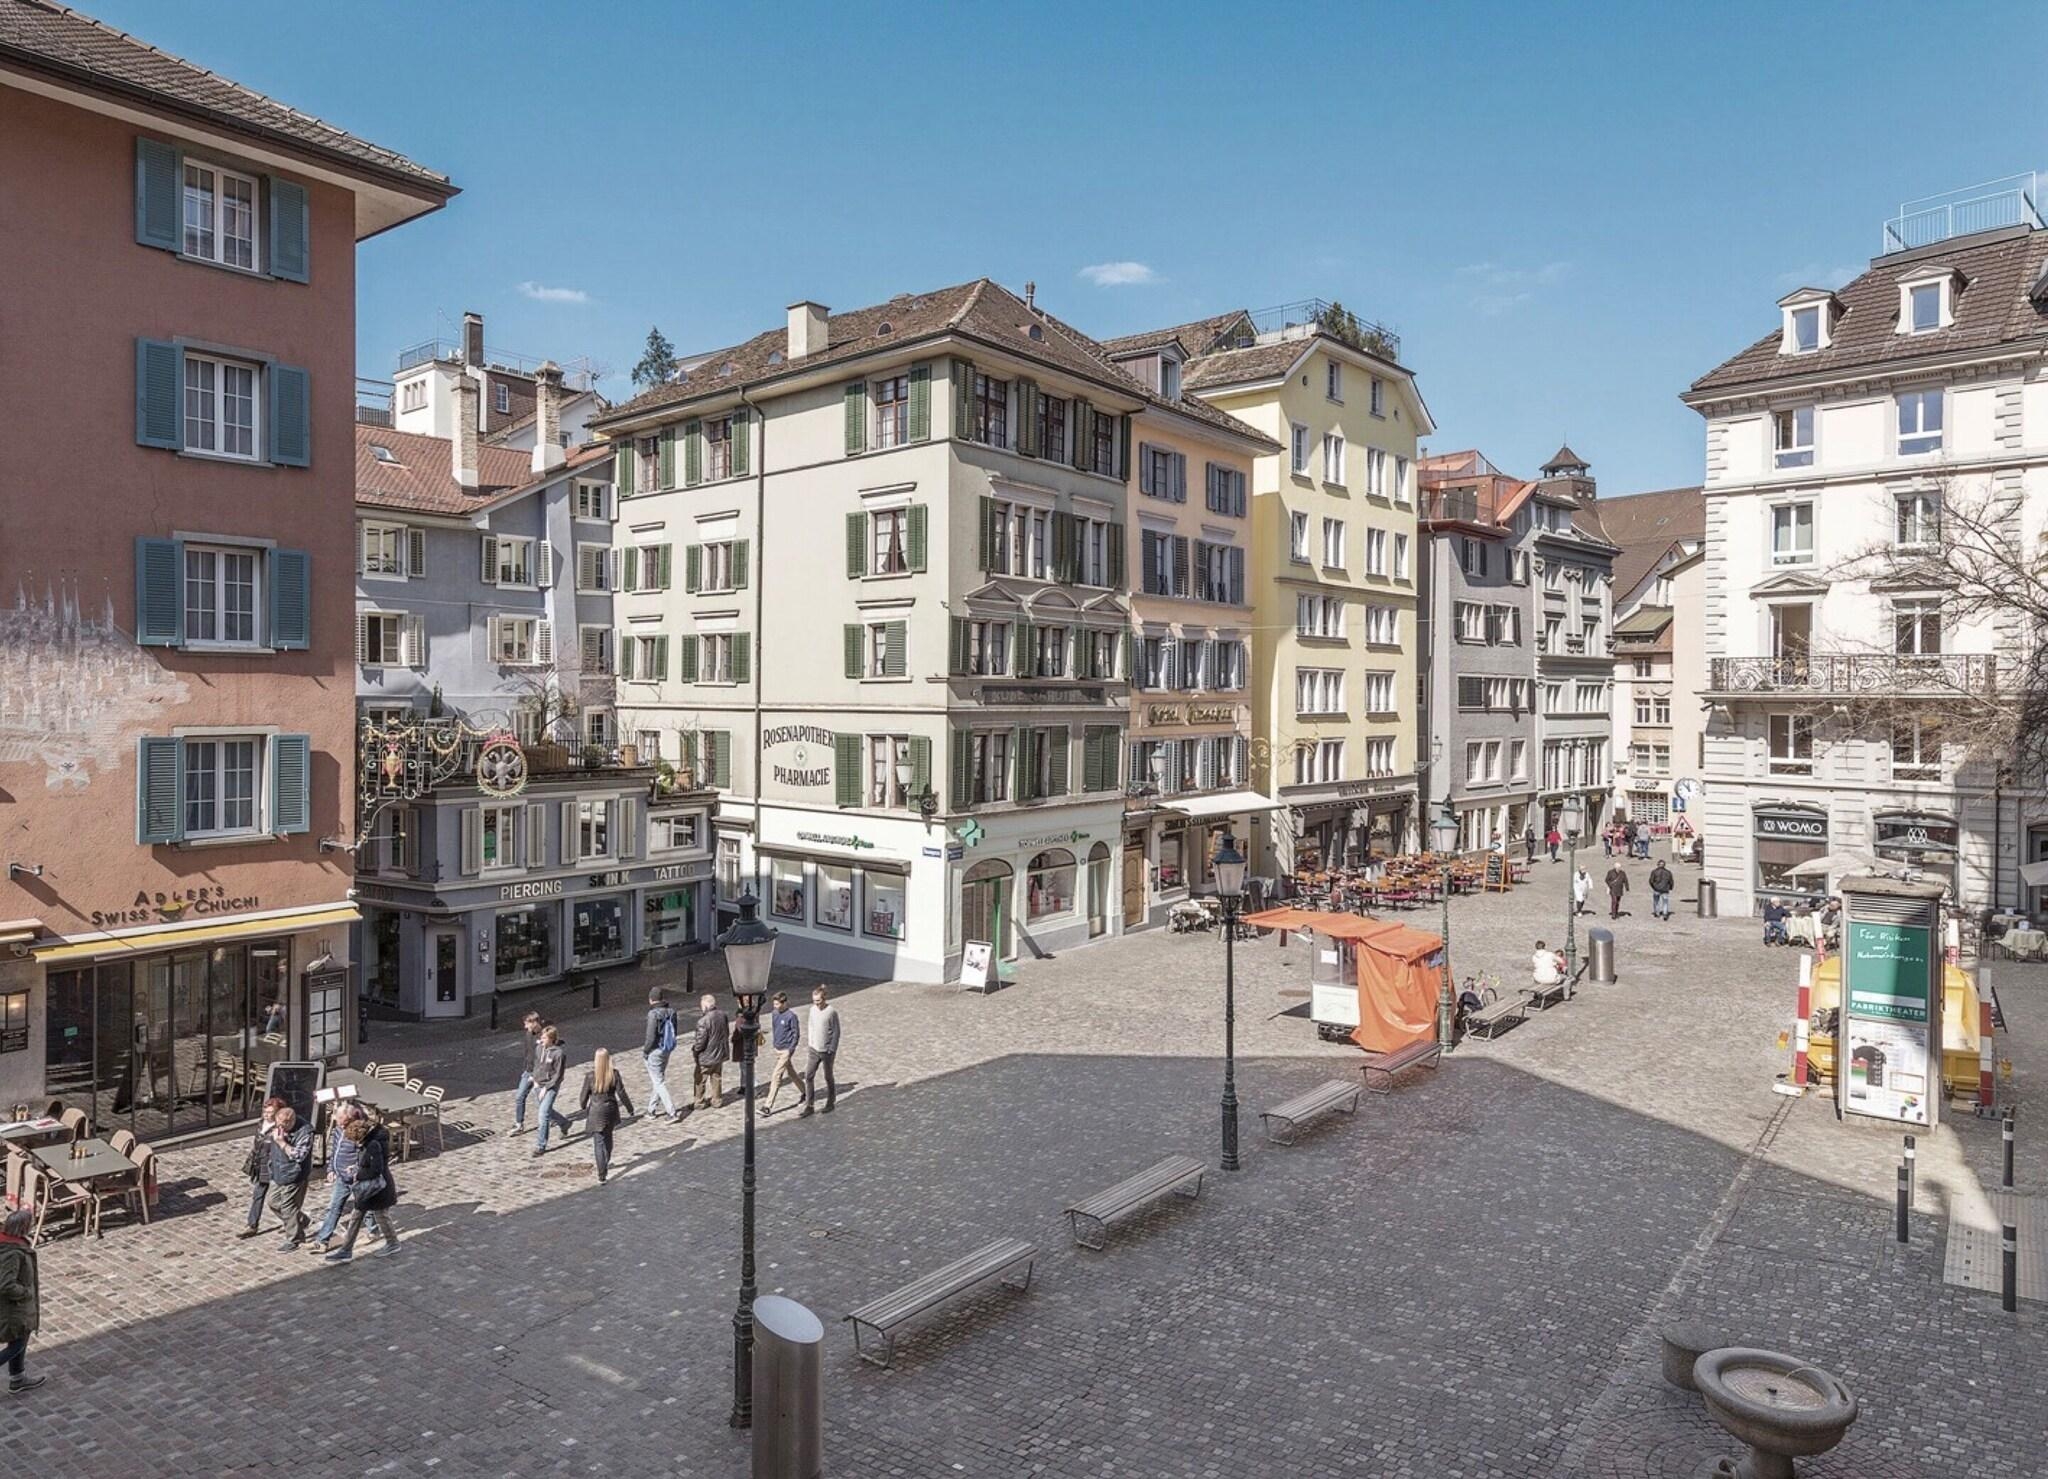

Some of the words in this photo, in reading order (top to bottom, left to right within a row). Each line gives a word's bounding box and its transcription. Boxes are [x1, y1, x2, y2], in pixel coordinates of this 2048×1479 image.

[763, 725, 835, 749] ROSENAPOTHEK
[774, 764, 831, 786] PHARMACIE
[1777, 821, 1822, 834] WOMO
[653, 864, 695, 880] TATTOO
[134, 886, 224, 907] ADLER'S
[500, 880, 562, 900] PIERCING
[91, 909, 149, 926] SWISS
[194, 896, 259, 914] CHUCHI
[1851, 1000, 1926, 1017] FABRIKTHEATER
